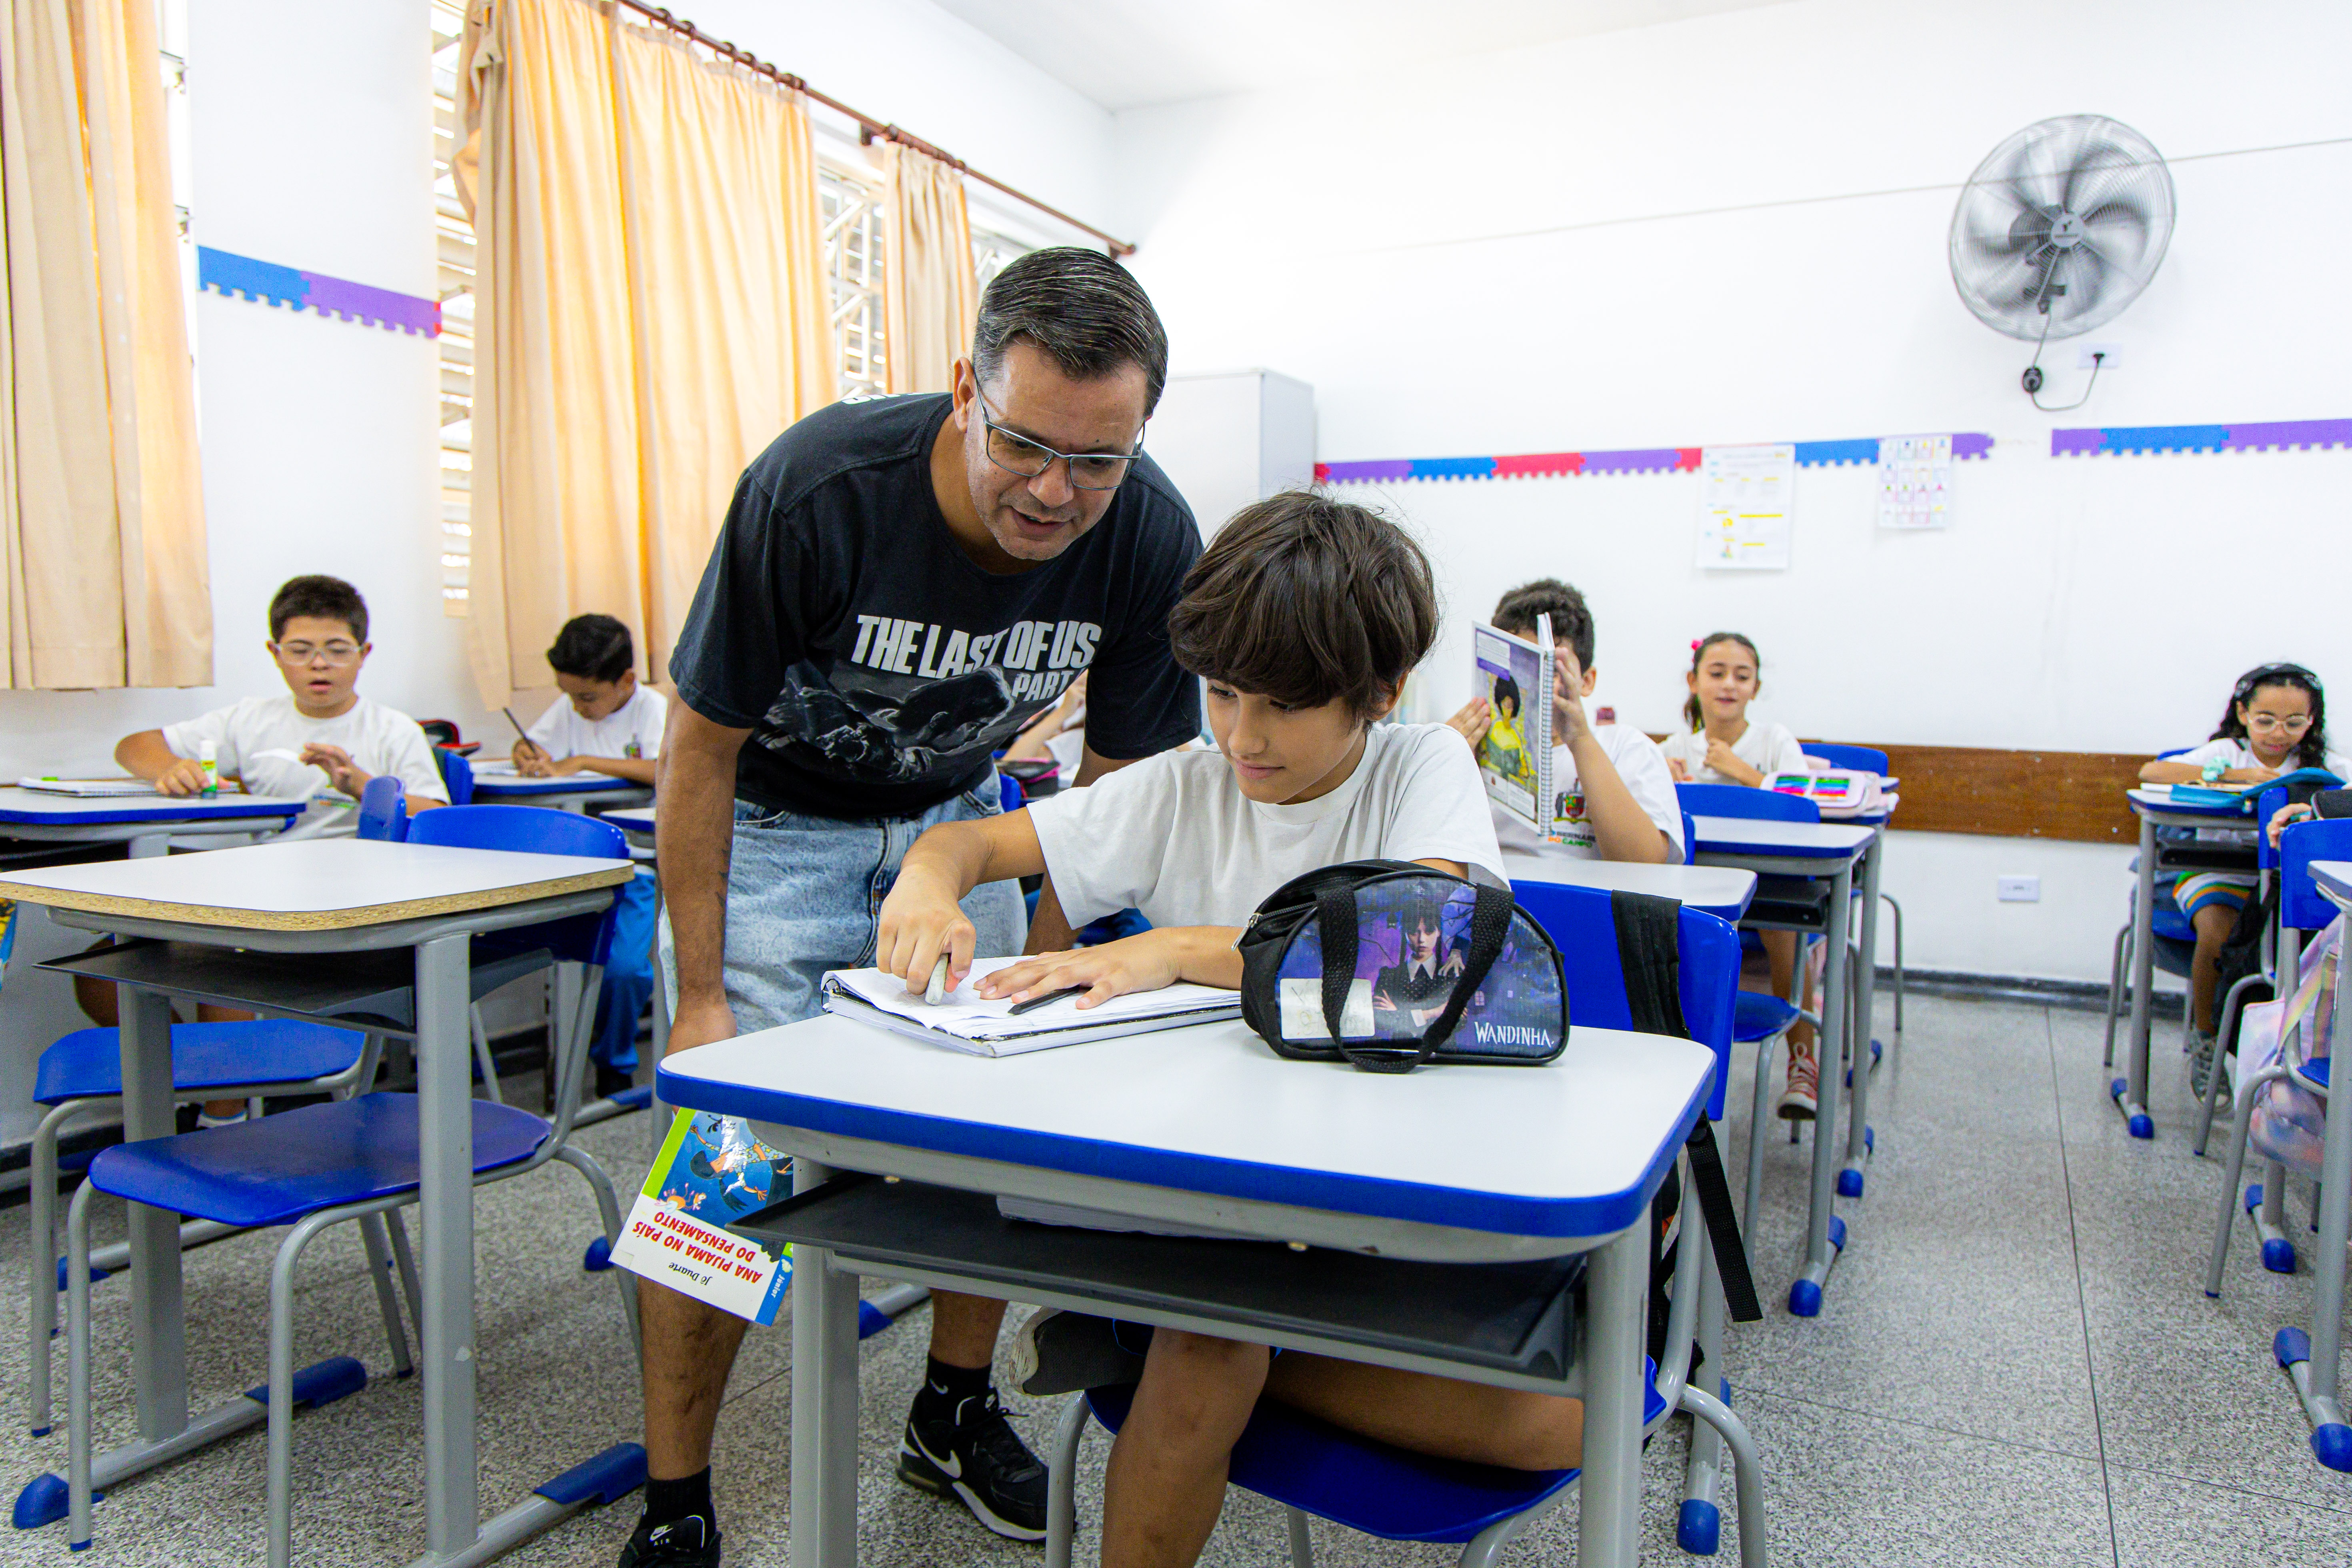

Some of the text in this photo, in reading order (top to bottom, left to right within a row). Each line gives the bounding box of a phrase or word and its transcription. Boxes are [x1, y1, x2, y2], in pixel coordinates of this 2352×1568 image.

[851, 614, 1102, 678] THE LAST OF US
[1012, 671, 1074, 701] PART
[1474, 1021, 1552, 1049] WANDINHA
[654, 1212, 756, 1262] DO PENSAMENTO
[632, 1222, 763, 1284] ANA PIJAMA NO PAÍS
[668, 1262, 700, 1282] Duarte
[771, 1274, 785, 1299] Júnior
